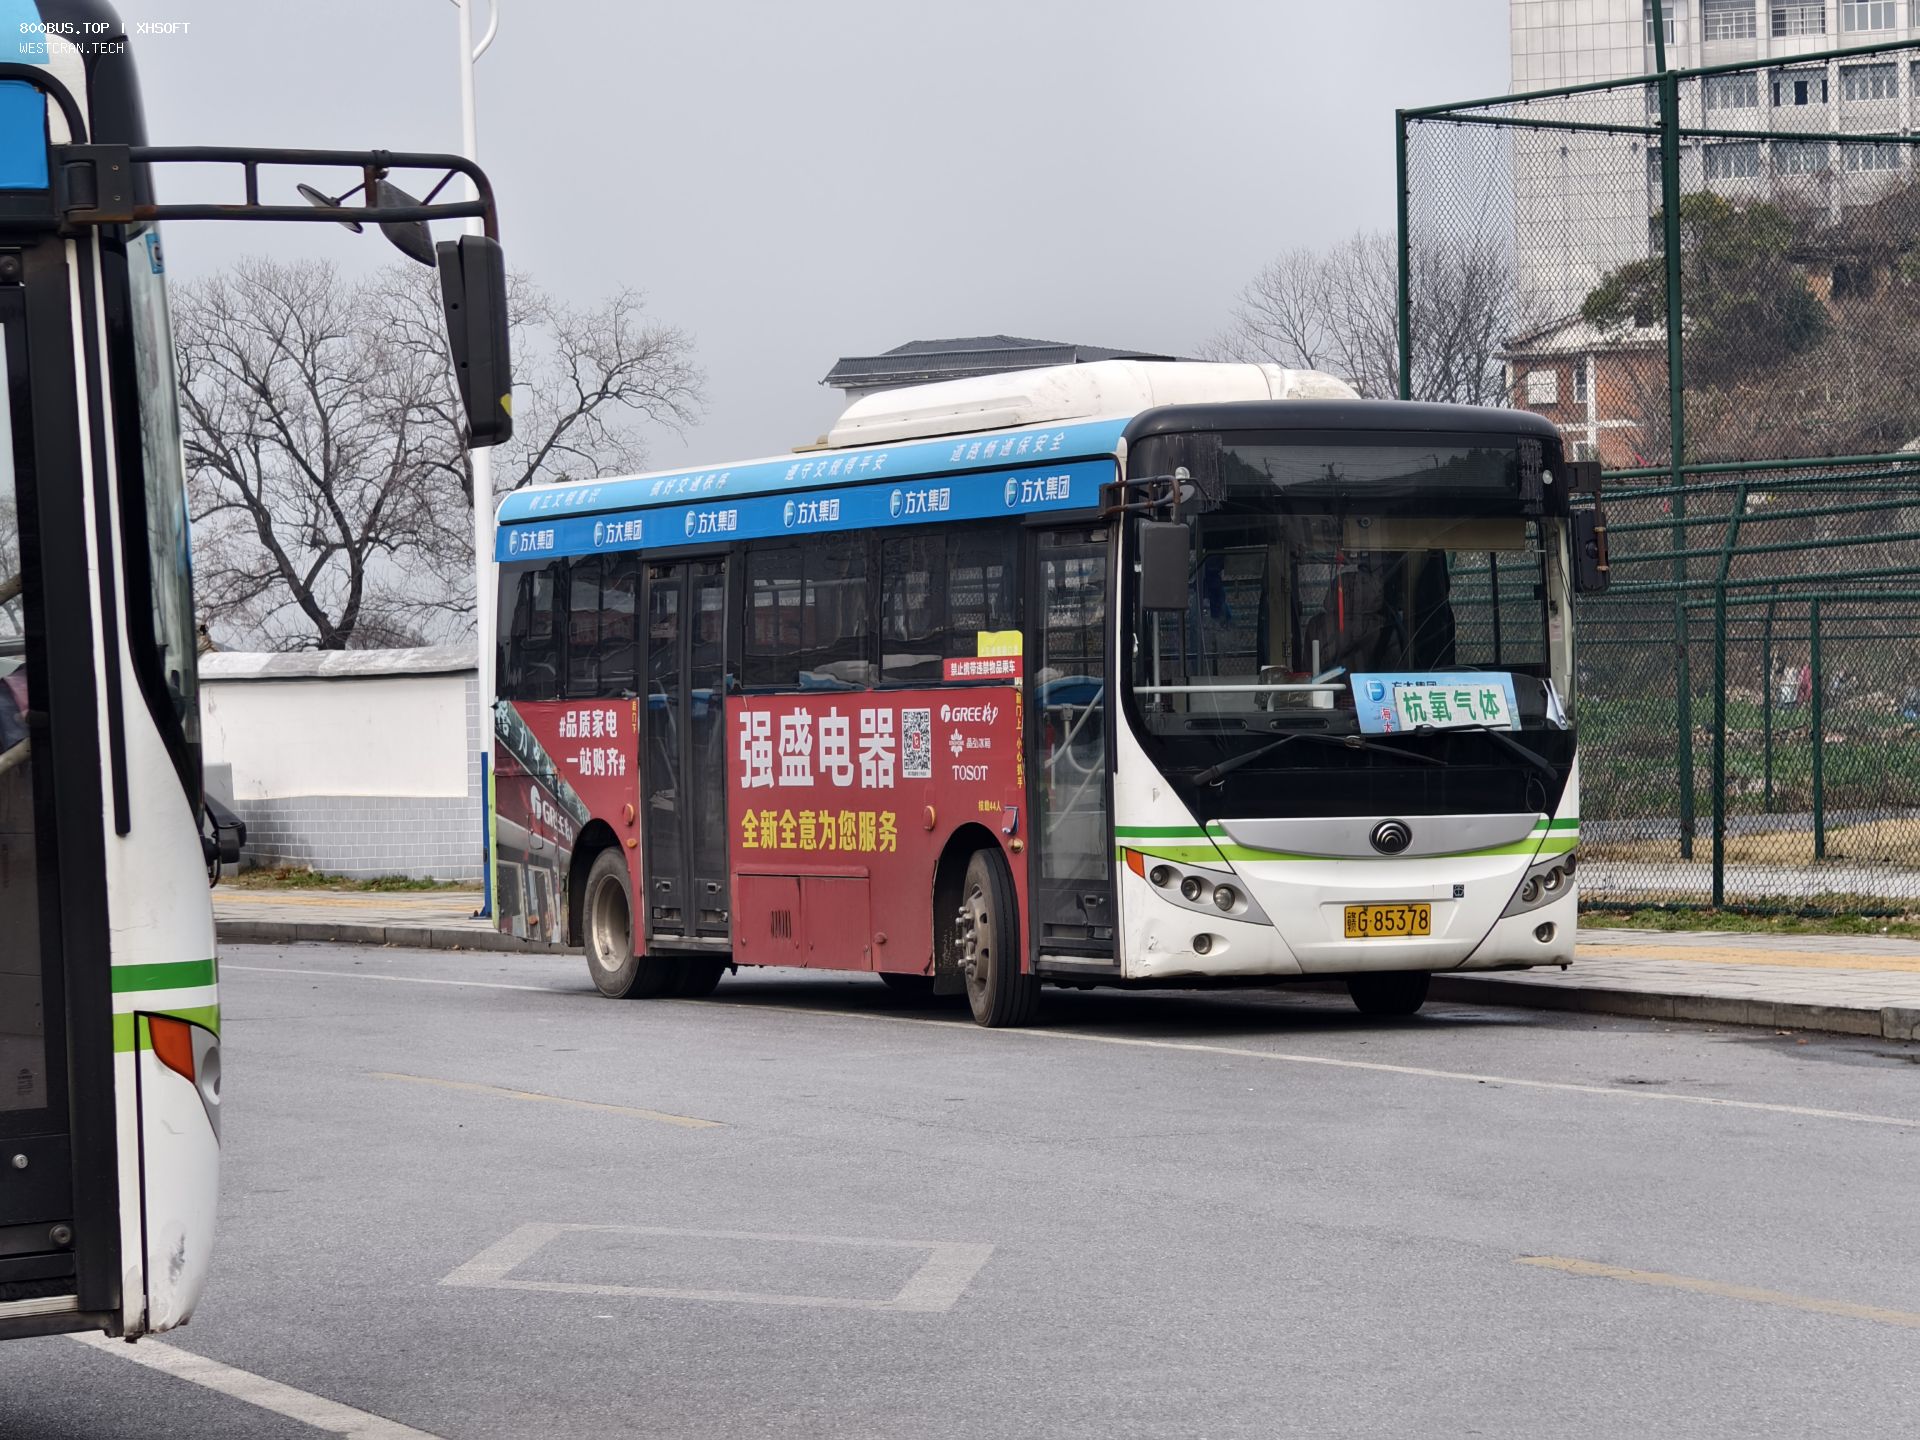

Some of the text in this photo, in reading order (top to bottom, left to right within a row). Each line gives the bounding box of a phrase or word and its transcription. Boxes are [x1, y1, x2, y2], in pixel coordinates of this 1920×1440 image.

[904, 488, 951, 514] 方大集团
[1020, 475, 1071, 503] 方大集团
[697, 509, 738, 534] 方大集团
[797, 498, 840, 524] 方大集团
[519, 529, 555, 553] 方大集团
[605, 519, 643, 544] 方大集团
[950, 660, 1016, 677] 禁止携带违禁物品乘车
[952, 706, 983, 722] GREE
[1402, 688, 1501, 723] 杭氧气体
[559, 709, 618, 738] #品质家电
[739, 706, 897, 790] 强盛电器
[566, 747, 626, 777] 一站购齐#
[952, 765, 989, 781] TOSOT
[741, 809, 898, 853] 全新全意为您服务
